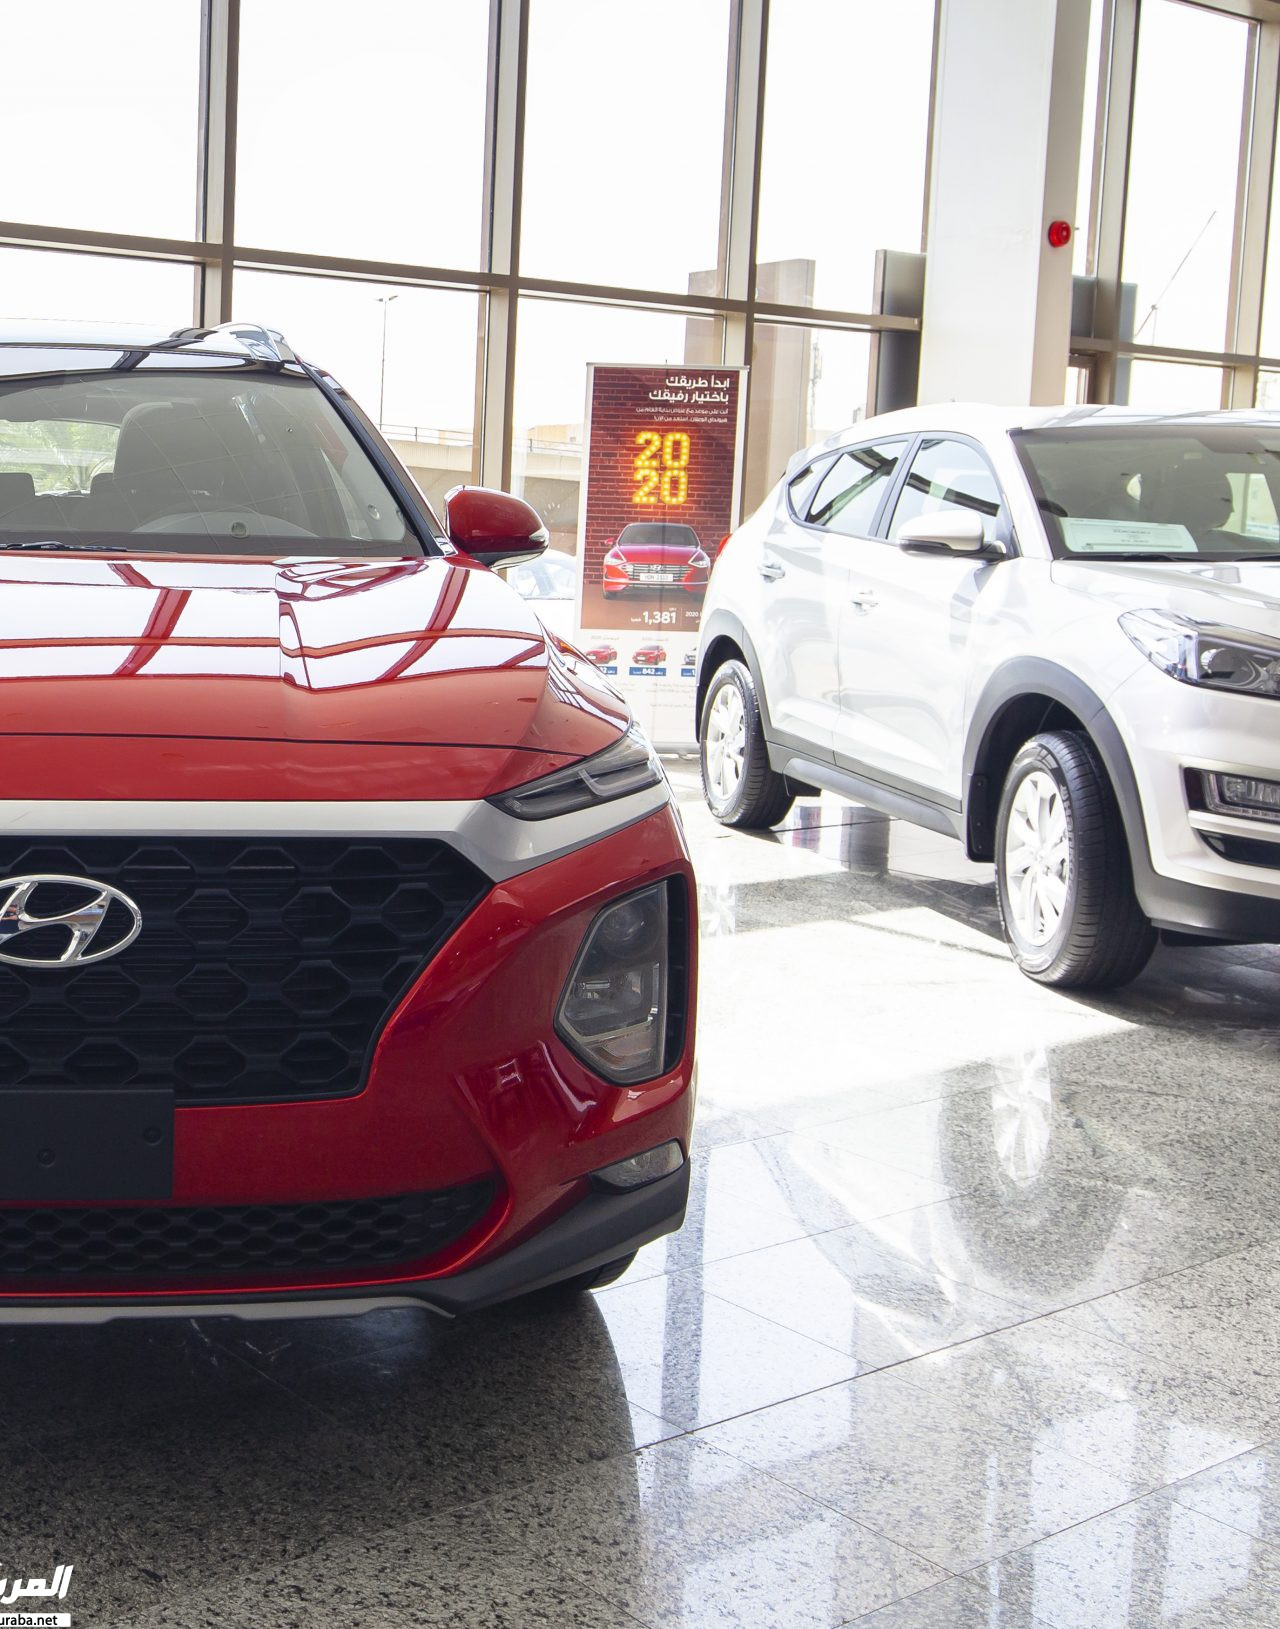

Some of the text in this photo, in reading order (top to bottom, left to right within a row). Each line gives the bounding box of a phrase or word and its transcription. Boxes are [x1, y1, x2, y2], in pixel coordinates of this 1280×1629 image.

[665, 375, 730, 390] ابدأ طريقك
[649, 390, 728, 404] باختيار رفيقك
[634, 431, 691, 469] 20
[632, 468, 688, 506] 20
[642, 610, 676, 625] 1,381
